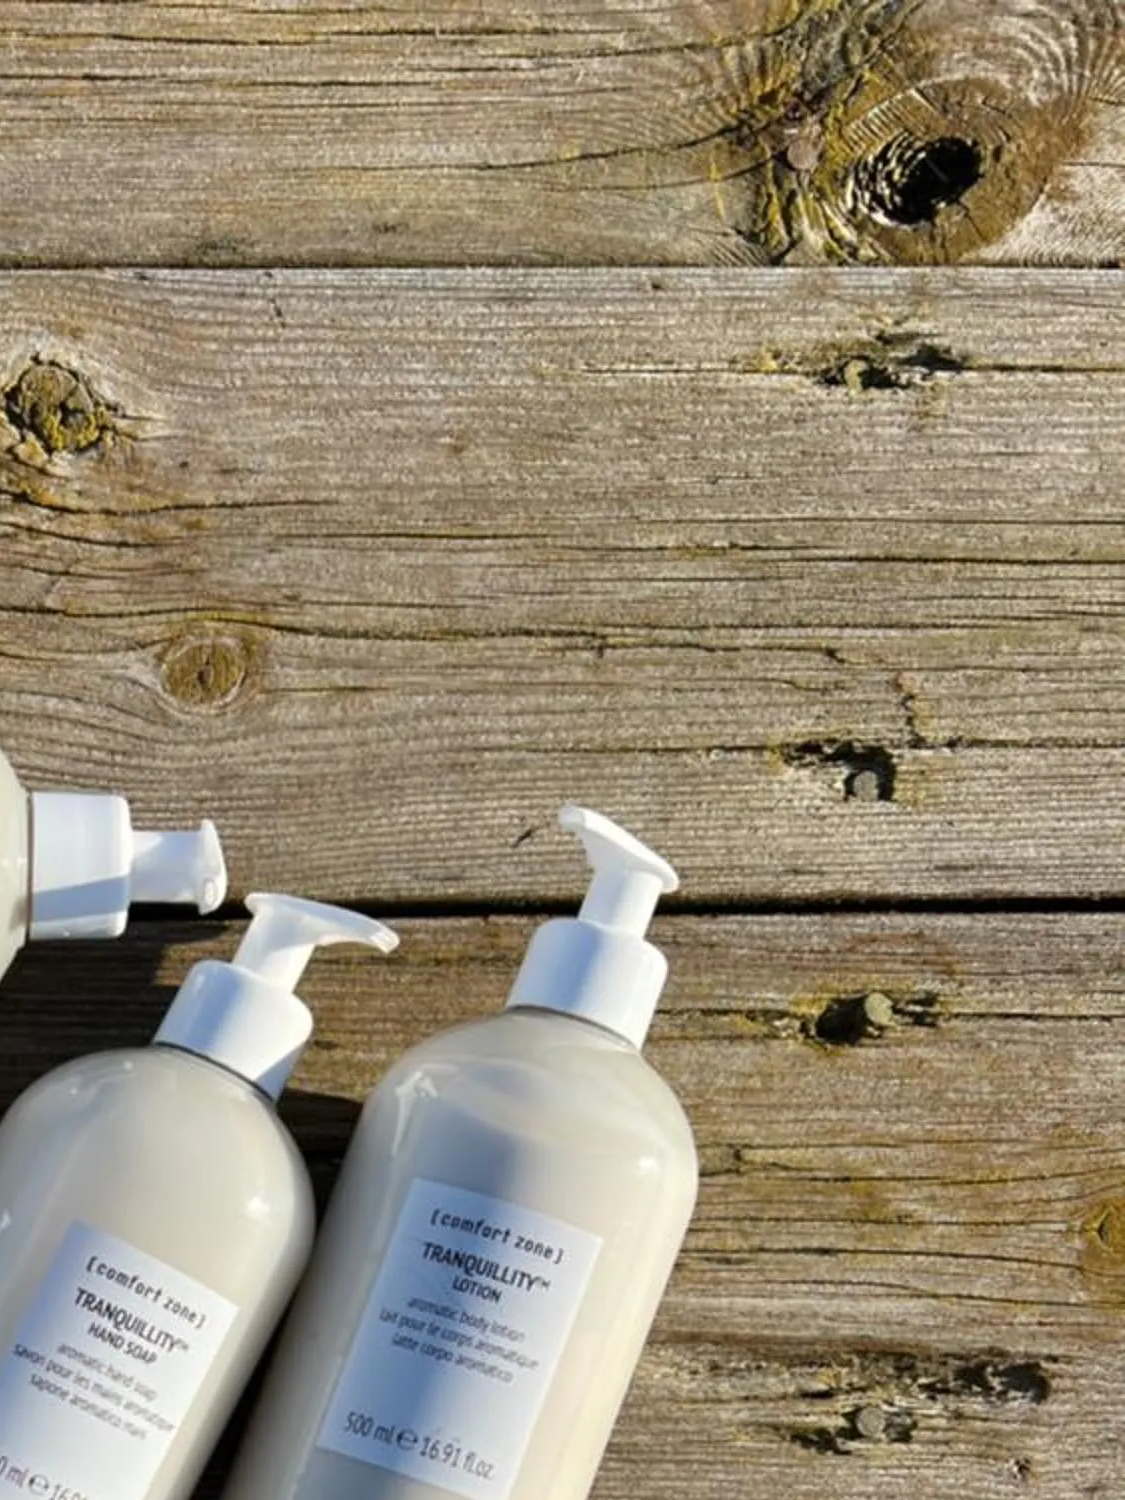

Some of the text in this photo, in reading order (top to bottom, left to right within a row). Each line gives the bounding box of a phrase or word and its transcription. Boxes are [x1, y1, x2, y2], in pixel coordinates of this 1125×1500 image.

[451, 1275, 501, 1303] LOTION
[87, 1321, 157, 1367] HAND SOAP
[343, 1410, 375, 1438] 500
[373, 1422, 396, 1445] ml
[4, 1463, 29, 1488] ml
